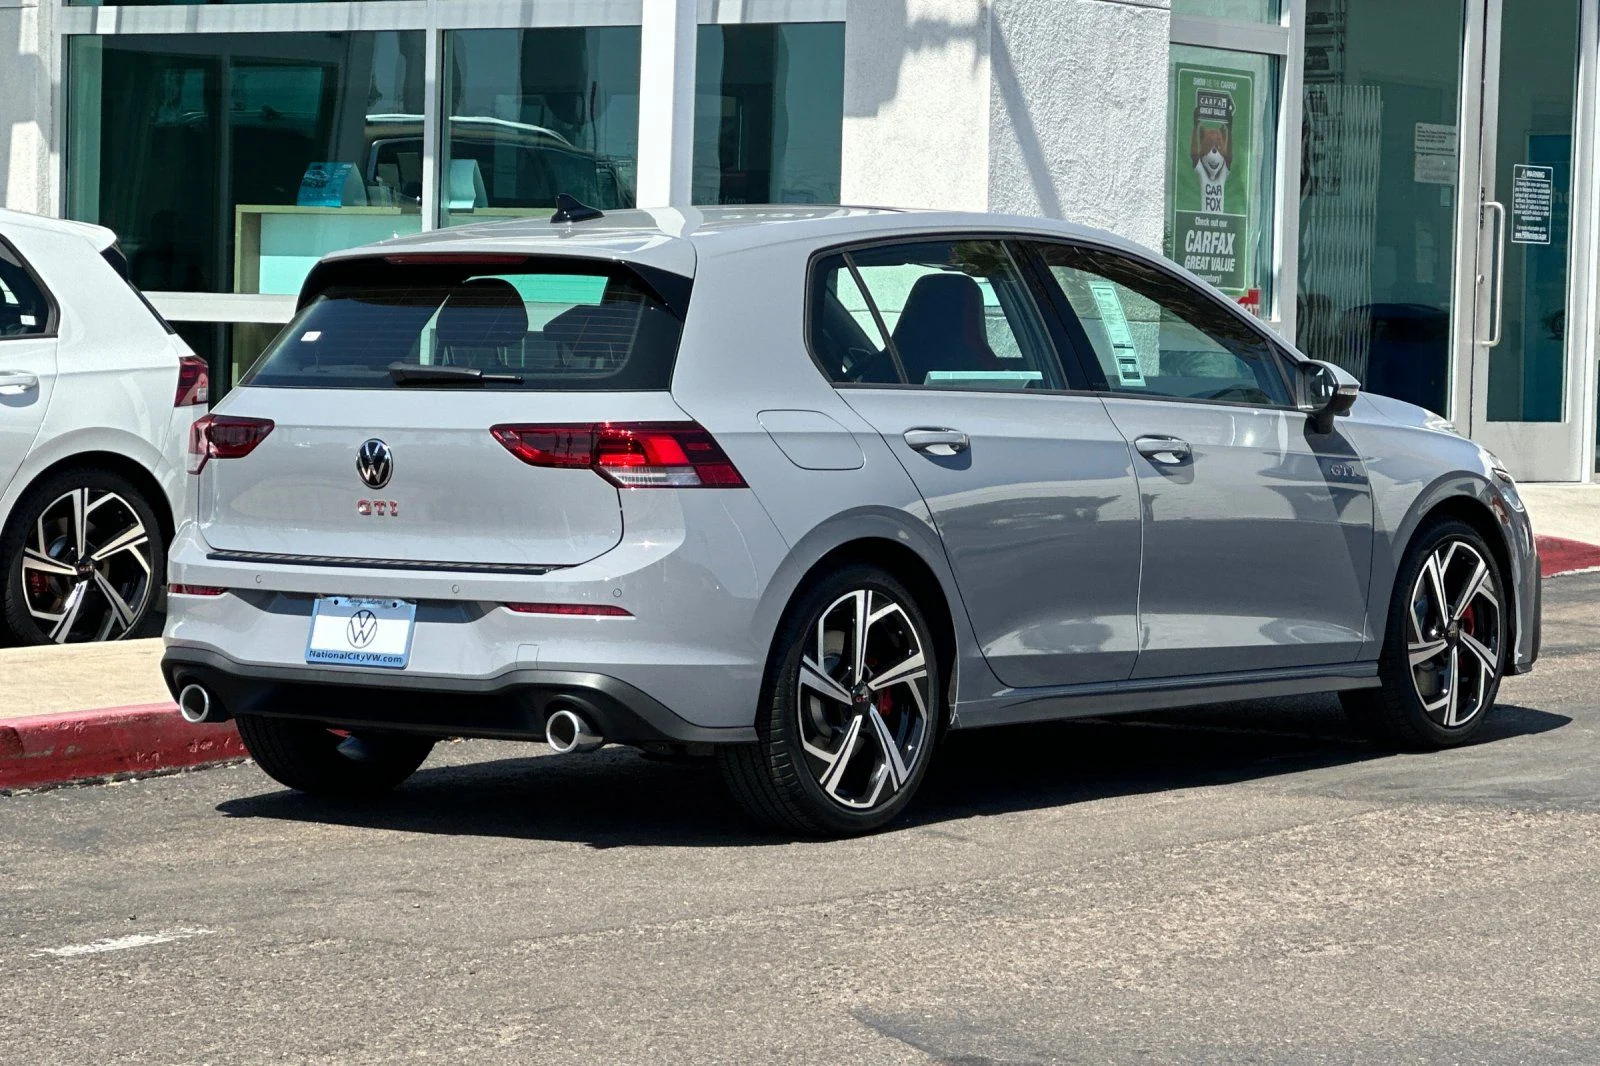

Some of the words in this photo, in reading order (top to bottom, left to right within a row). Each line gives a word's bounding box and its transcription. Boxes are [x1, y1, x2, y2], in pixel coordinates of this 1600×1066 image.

[1526, 170, 1545, 178] WARNING
[1205, 183, 1222, 196] CAR
[1205, 197, 1222, 211] FOX
[1195, 216, 1209, 226] Check
[1185, 229, 1236, 255] CARFAX
[1184, 255, 1210, 271] GREAT
[1211, 257, 1236, 272] VALUE
[358, 500, 398, 516] GTI
[309, 650, 403, 663] NationalCityVW.com
